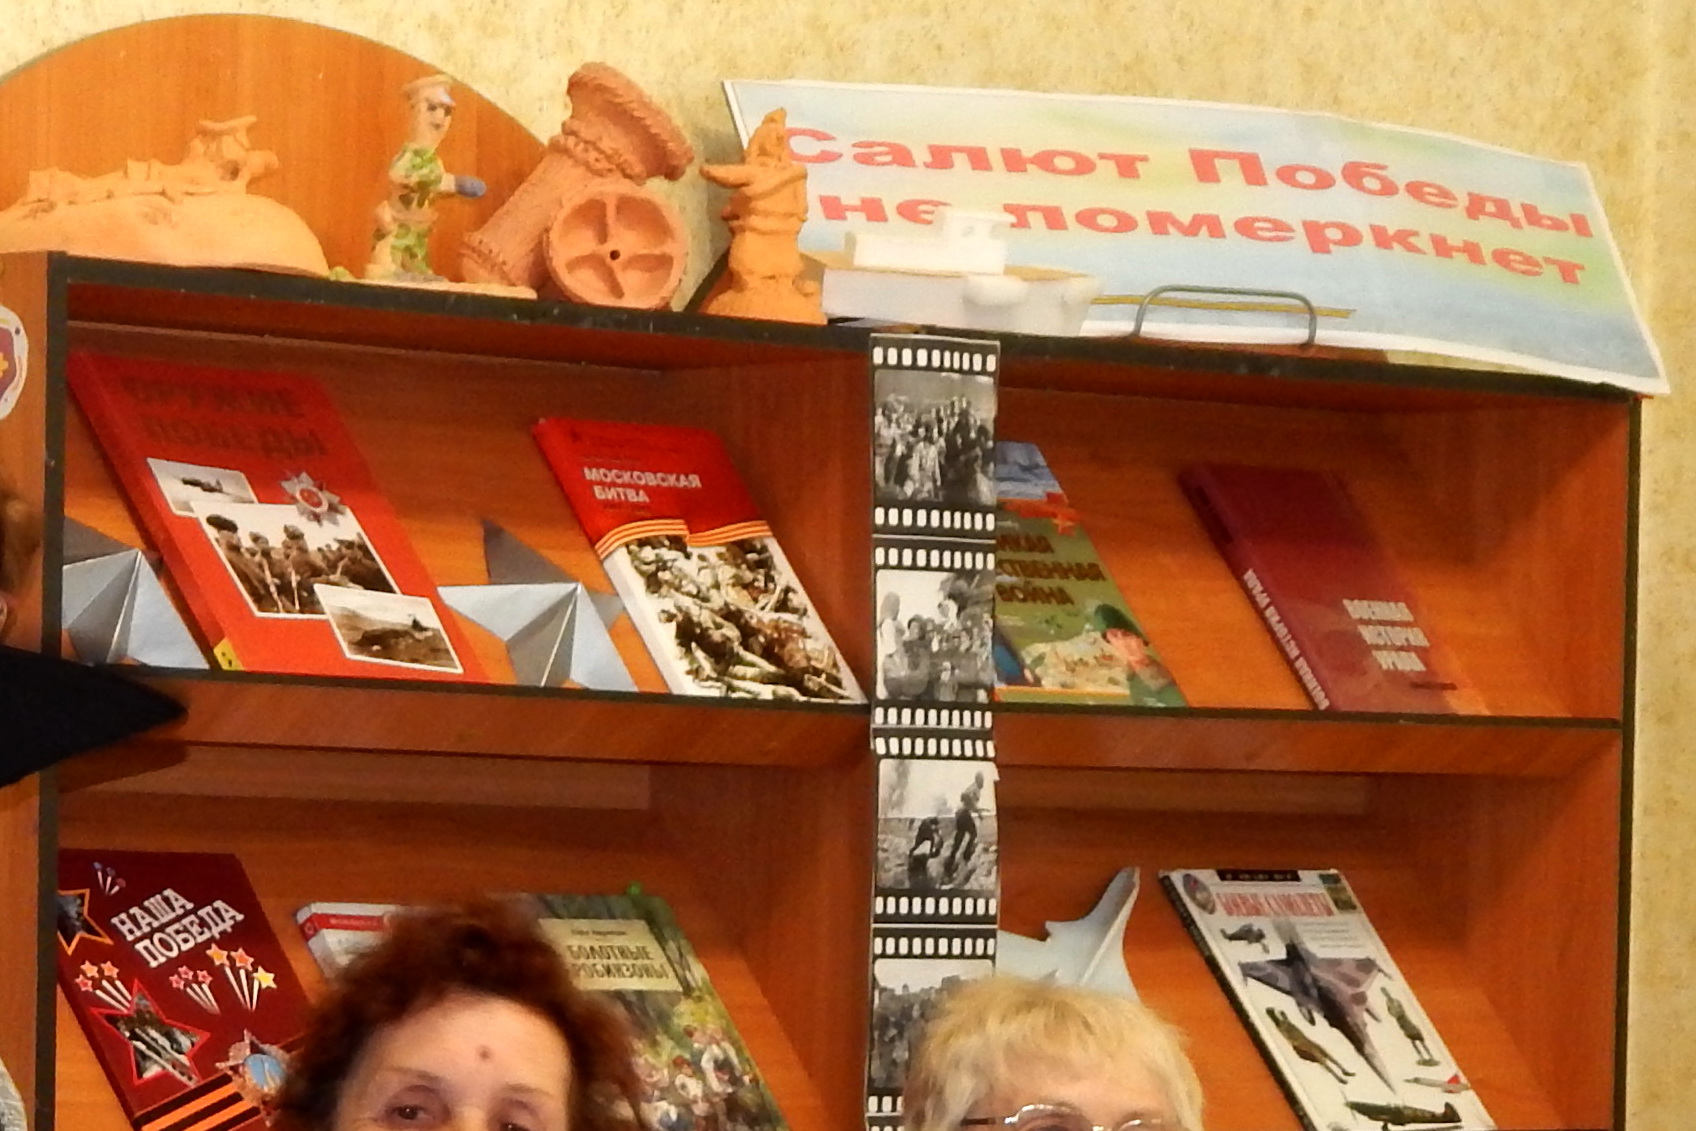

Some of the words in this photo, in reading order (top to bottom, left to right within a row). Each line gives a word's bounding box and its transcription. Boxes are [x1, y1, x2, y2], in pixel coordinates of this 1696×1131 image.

[785, 127, 1150, 179] Салют
[1188, 148, 1595, 238] Победы
[1003, 203, 1586, 285] померкнет
[583, 466, 702, 488] МОСКОВСКАЯ
[592, 485, 650, 502] БИТВА
[110, 888, 194, 941] НАША
[134, 899, 245, 968] ПОБЕДА
[567, 944, 654, 961] БОЛОТНЫЕ
[572, 962, 670, 979] РОБИНЗОНЫ
